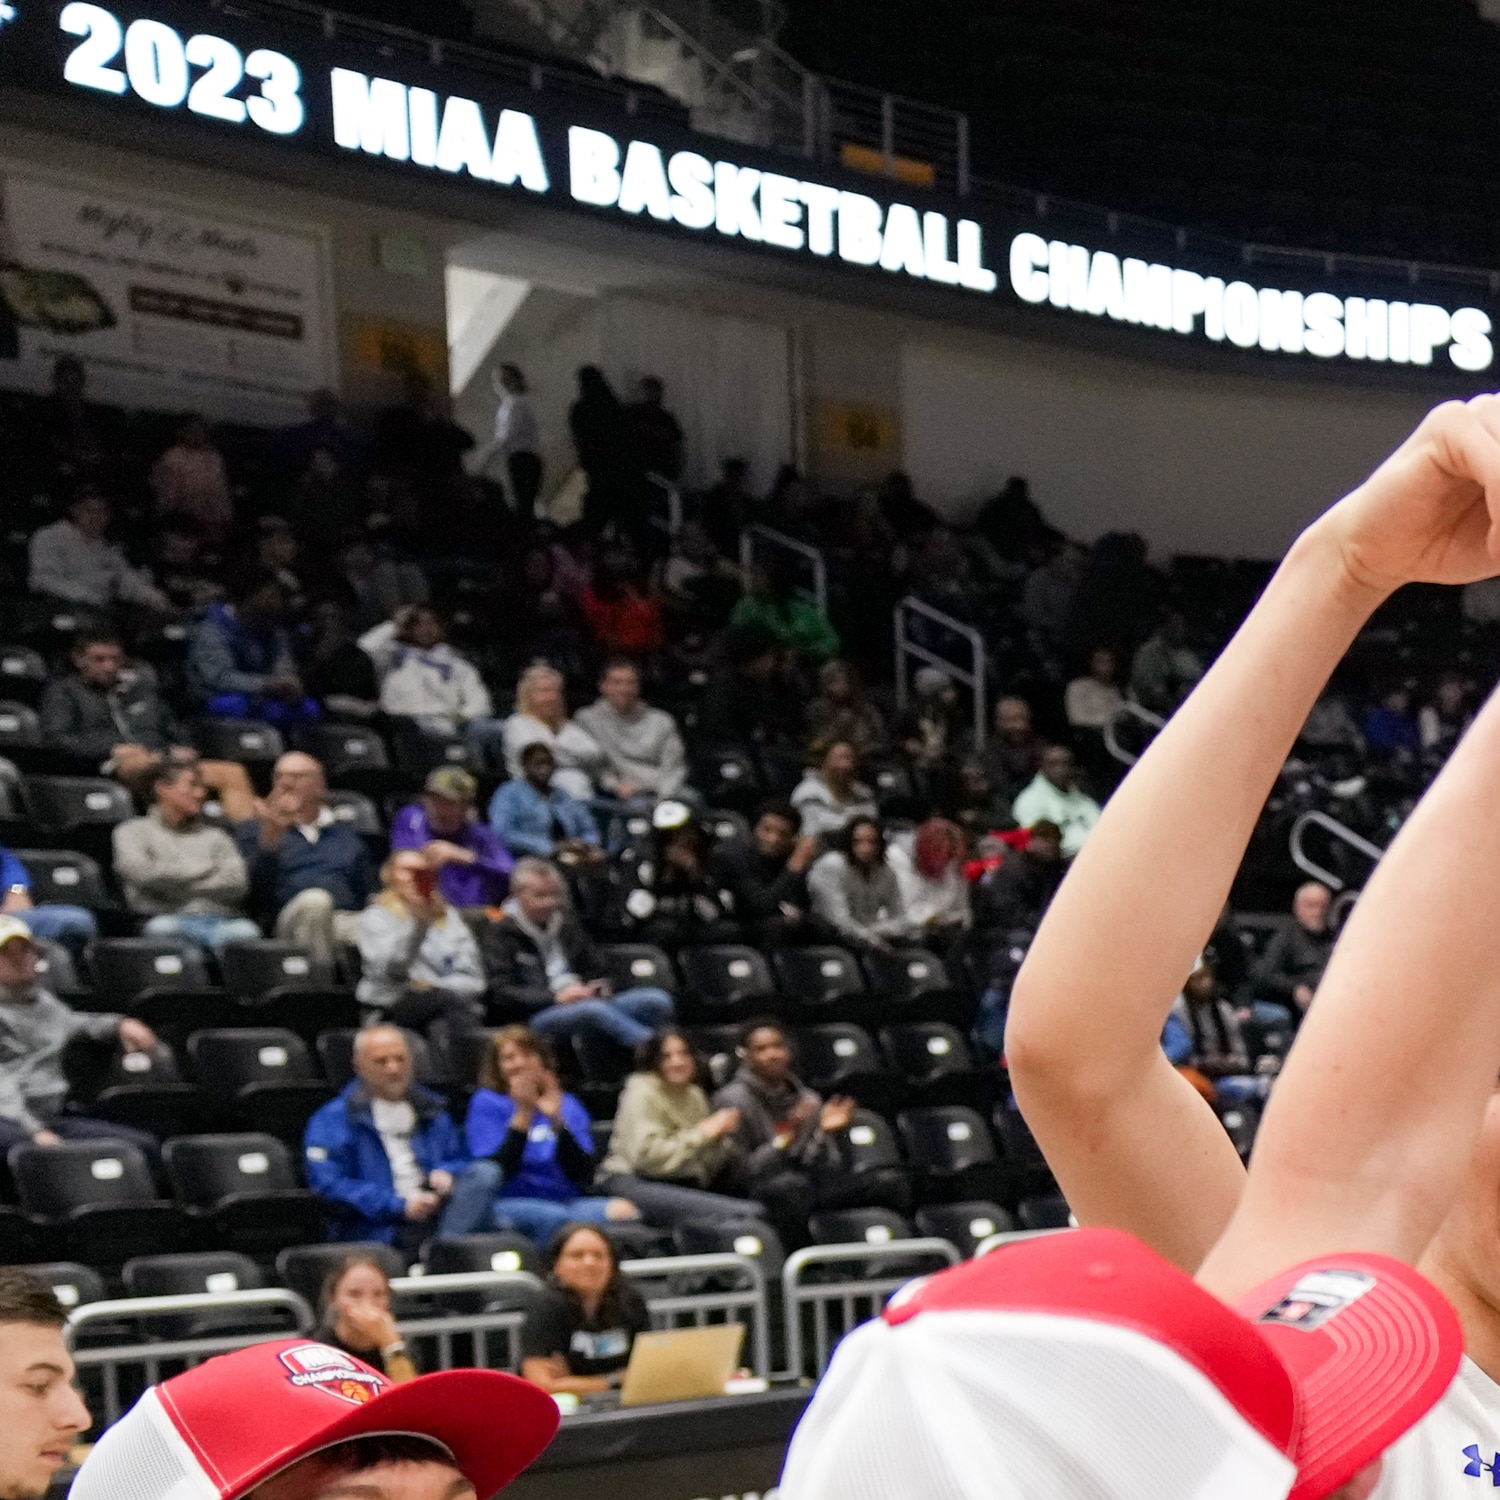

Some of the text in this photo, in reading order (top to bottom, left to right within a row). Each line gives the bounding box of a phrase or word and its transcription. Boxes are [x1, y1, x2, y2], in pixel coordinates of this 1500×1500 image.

[59, 2, 303, 134] 2023
[331, 67, 548, 192] MIAA
[568, 125, 996, 292] BASKETBALL
[1009, 232, 1493, 371] CHAMPIONSHIPS
